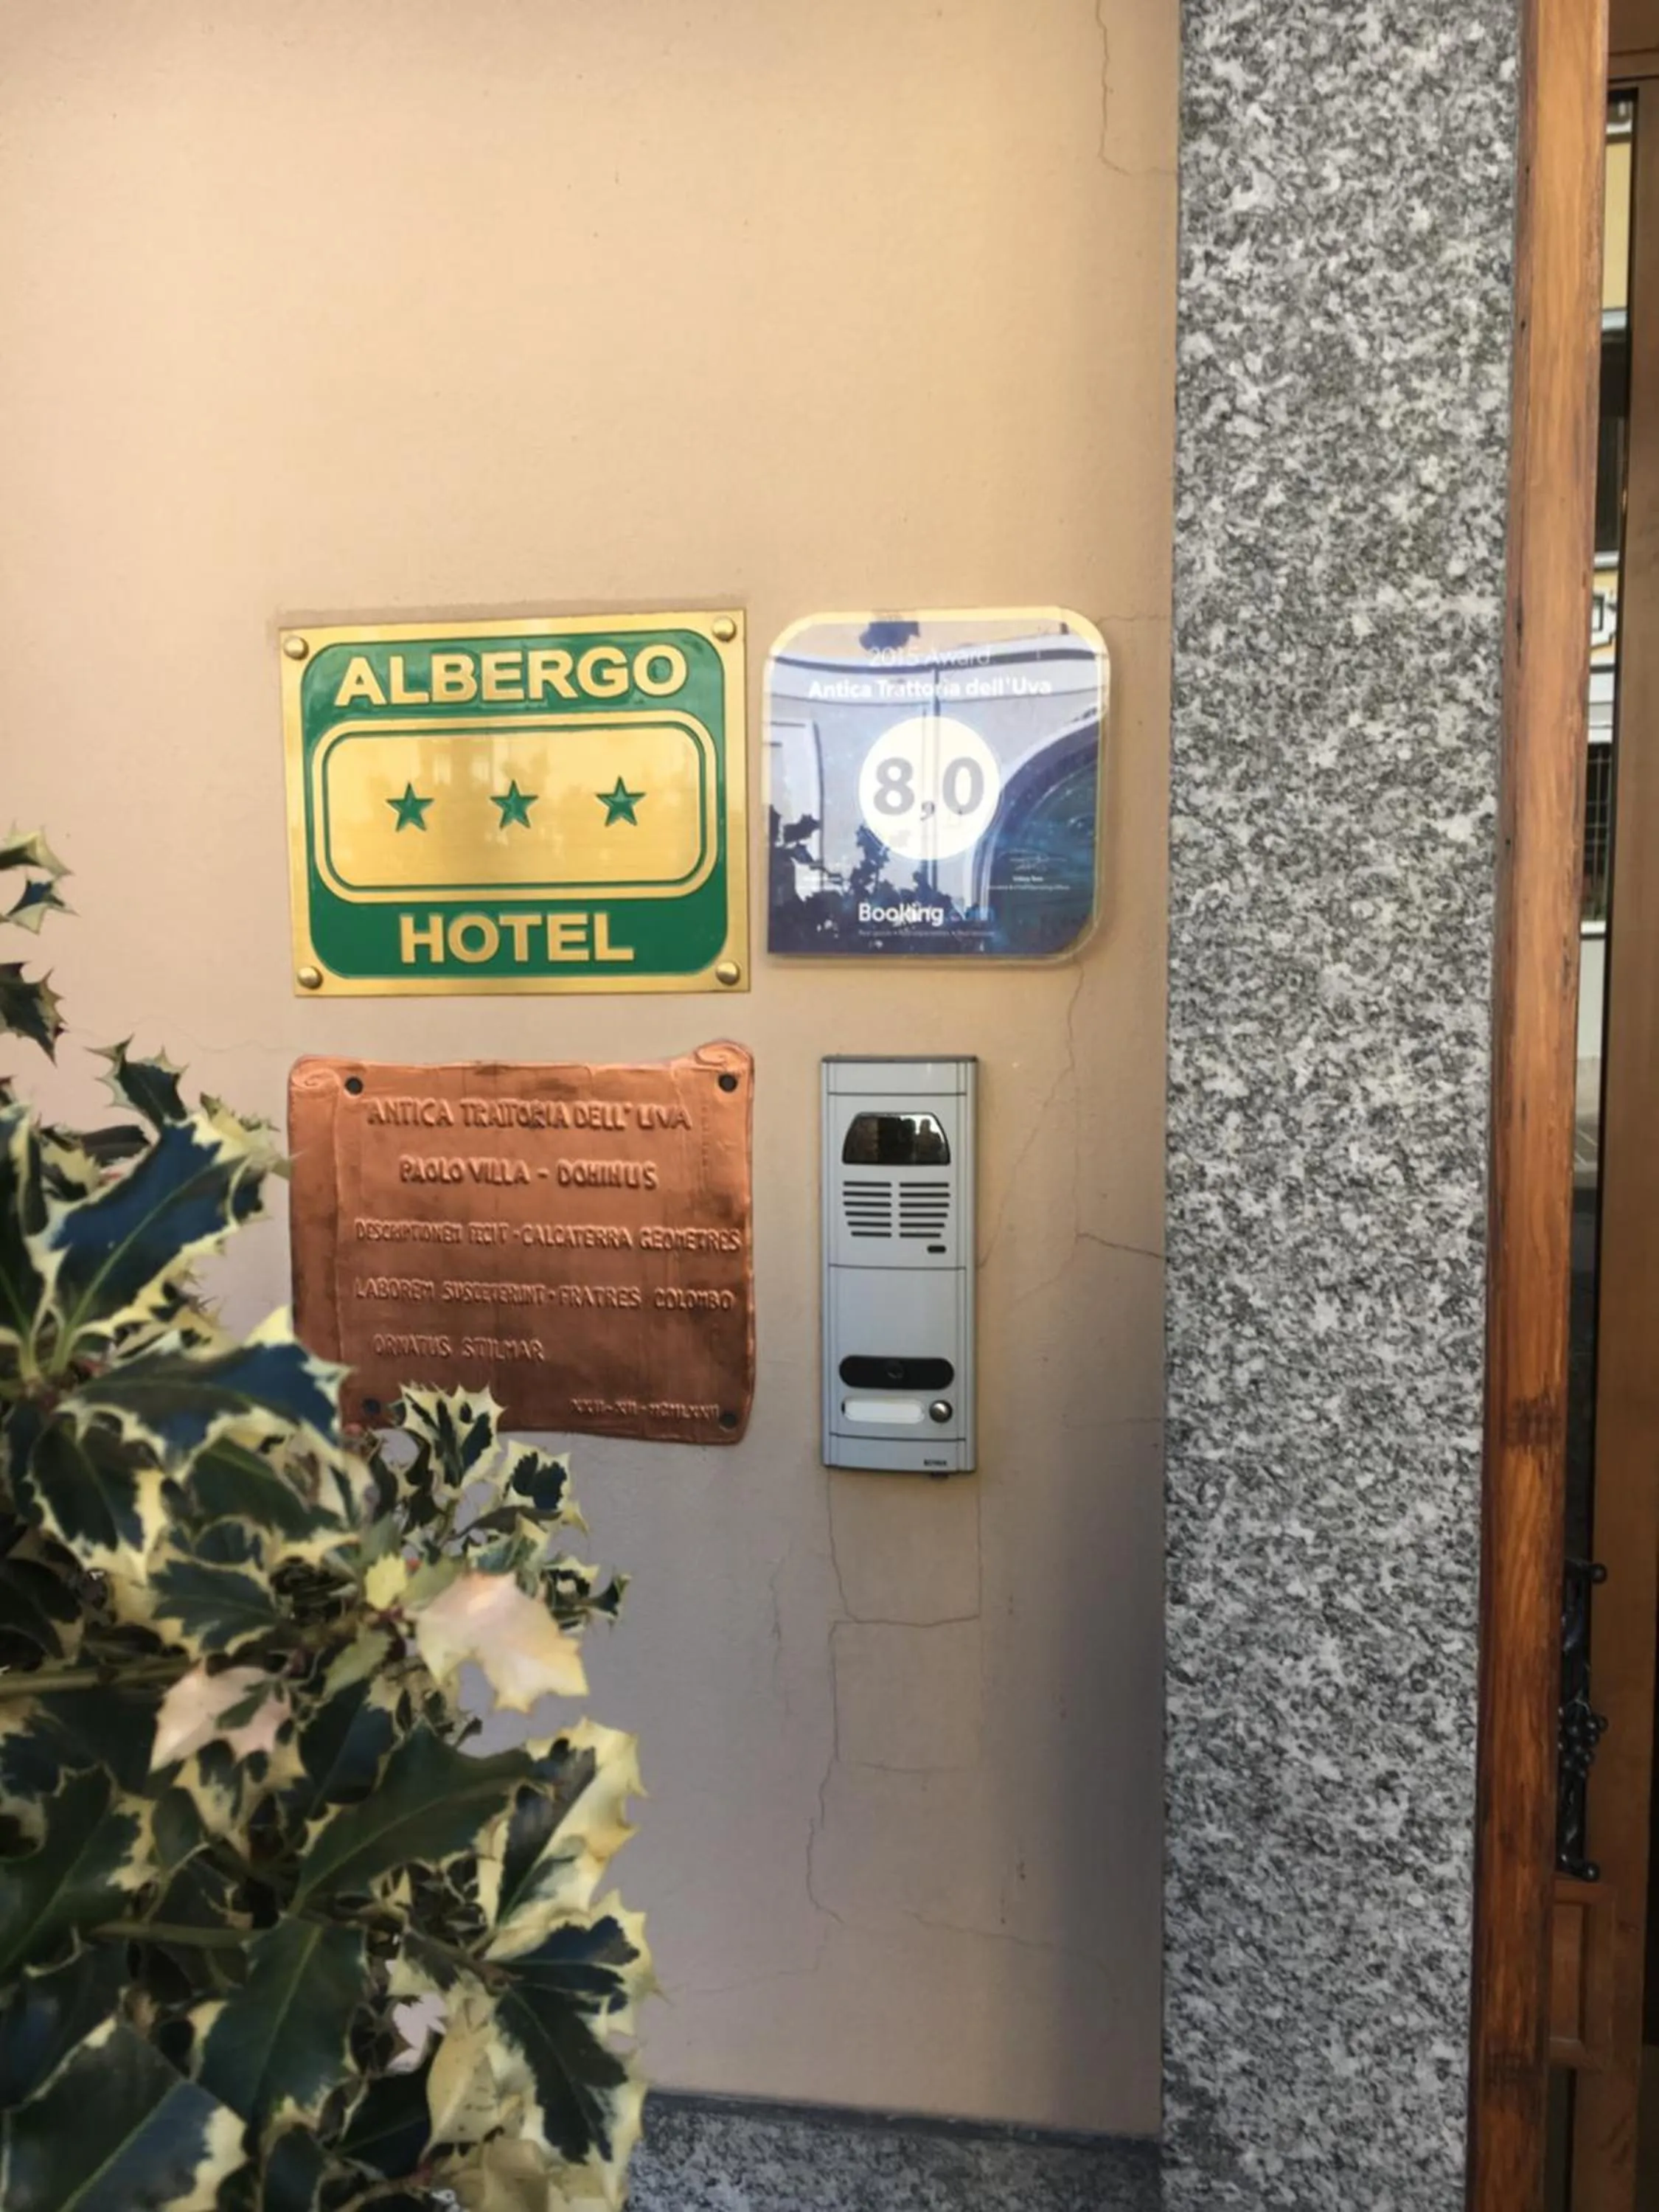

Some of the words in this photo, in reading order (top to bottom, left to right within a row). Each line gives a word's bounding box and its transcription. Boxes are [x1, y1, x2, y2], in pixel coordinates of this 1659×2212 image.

[334, 644, 687, 707] ALBERGO
[810, 680, 872, 698] Antica
[966, 676, 1052, 696] dell'Uva
[874, 757, 984, 821] 8,0
[400, 912, 635, 964] HOTEL
[367, 1097, 455, 1128] ANTICA
[459, 1098, 570, 1130] TRATTORIA
[637, 1103, 693, 1131] UVA
[398, 1155, 465, 1184] PAOLO
[467, 1157, 530, 1186] VILLA
[521, 1224, 633, 1250] CALCATERRA
[355, 1277, 434, 1301] LABOREM
[558, 1285, 642, 1309] FRATRES
[654, 1287, 736, 1311] COLOMBO
